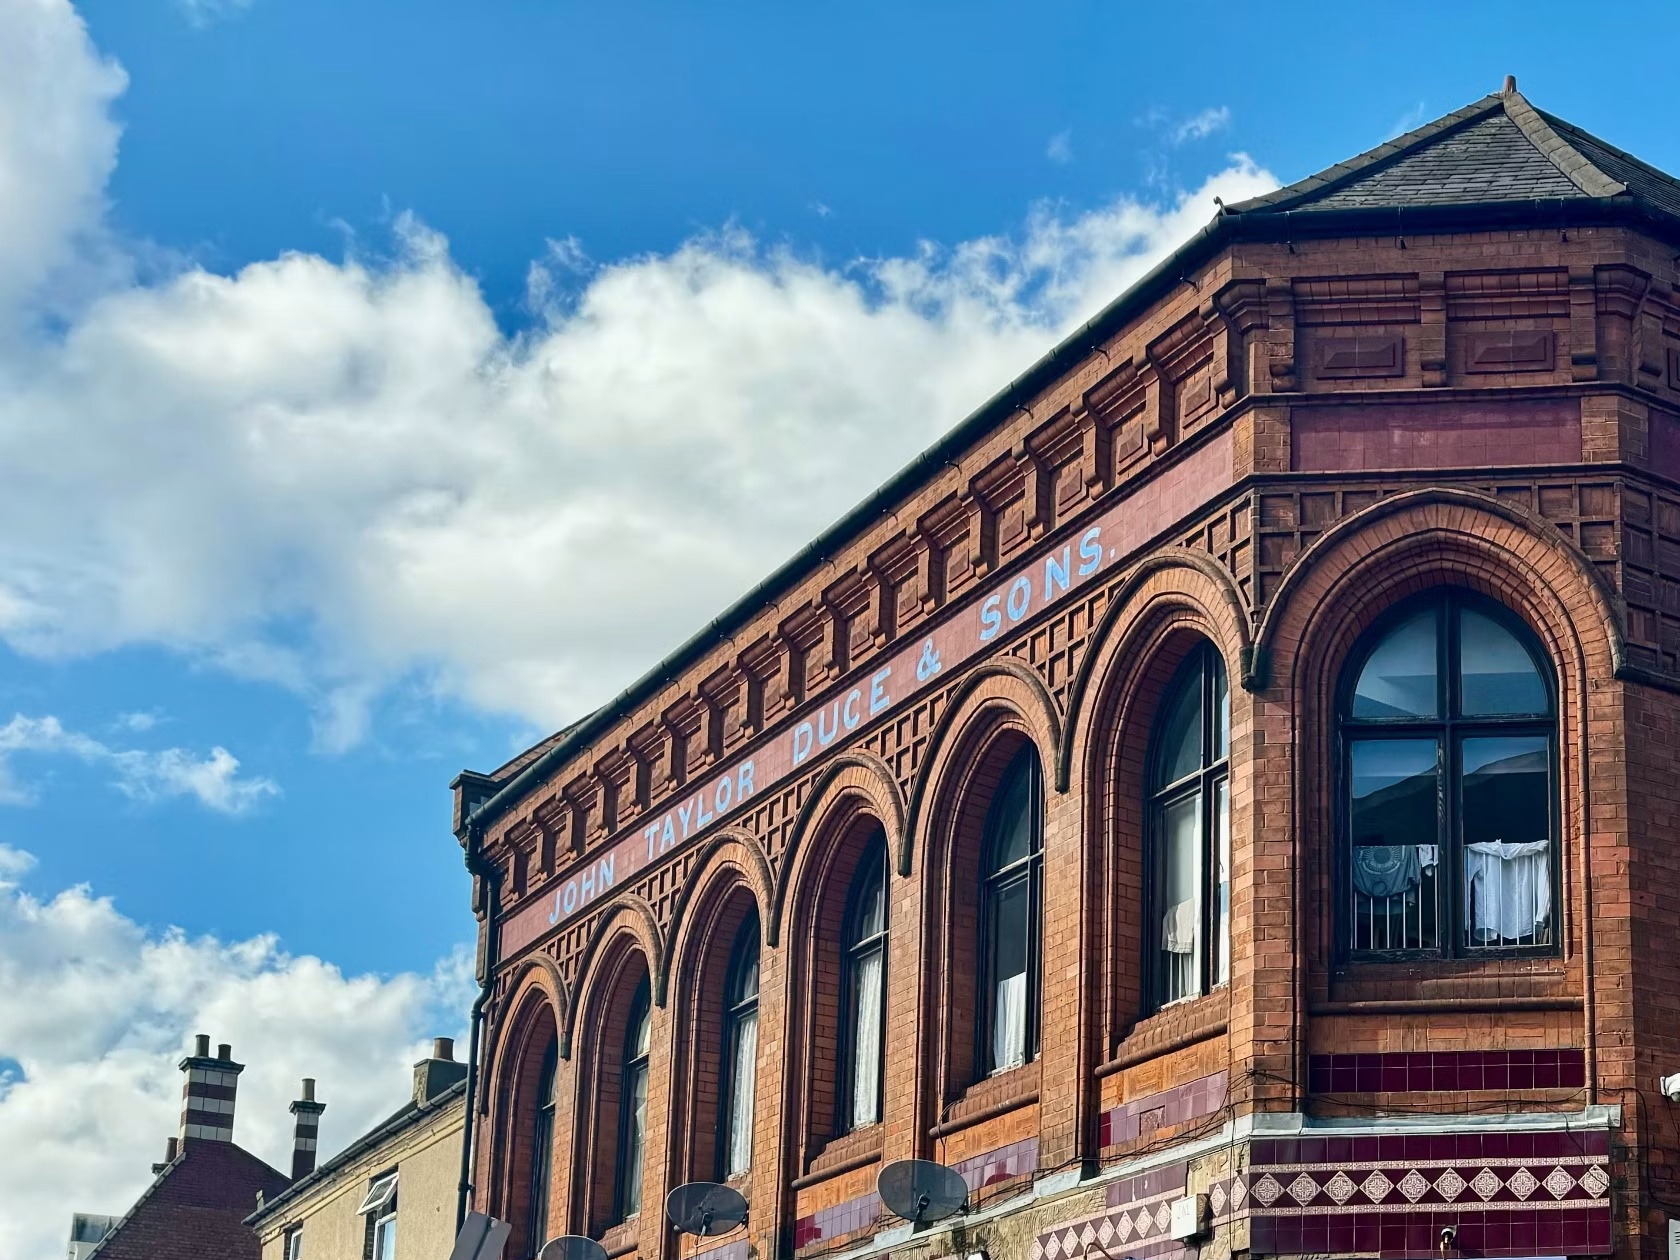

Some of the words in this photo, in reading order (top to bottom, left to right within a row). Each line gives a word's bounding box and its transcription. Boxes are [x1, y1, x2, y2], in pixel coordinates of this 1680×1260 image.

[548, 850, 616, 926] JOHN
[643, 759, 756, 860] TAYLOR
[791, 665, 892, 766] DUCE
[916, 637, 943, 682] &
